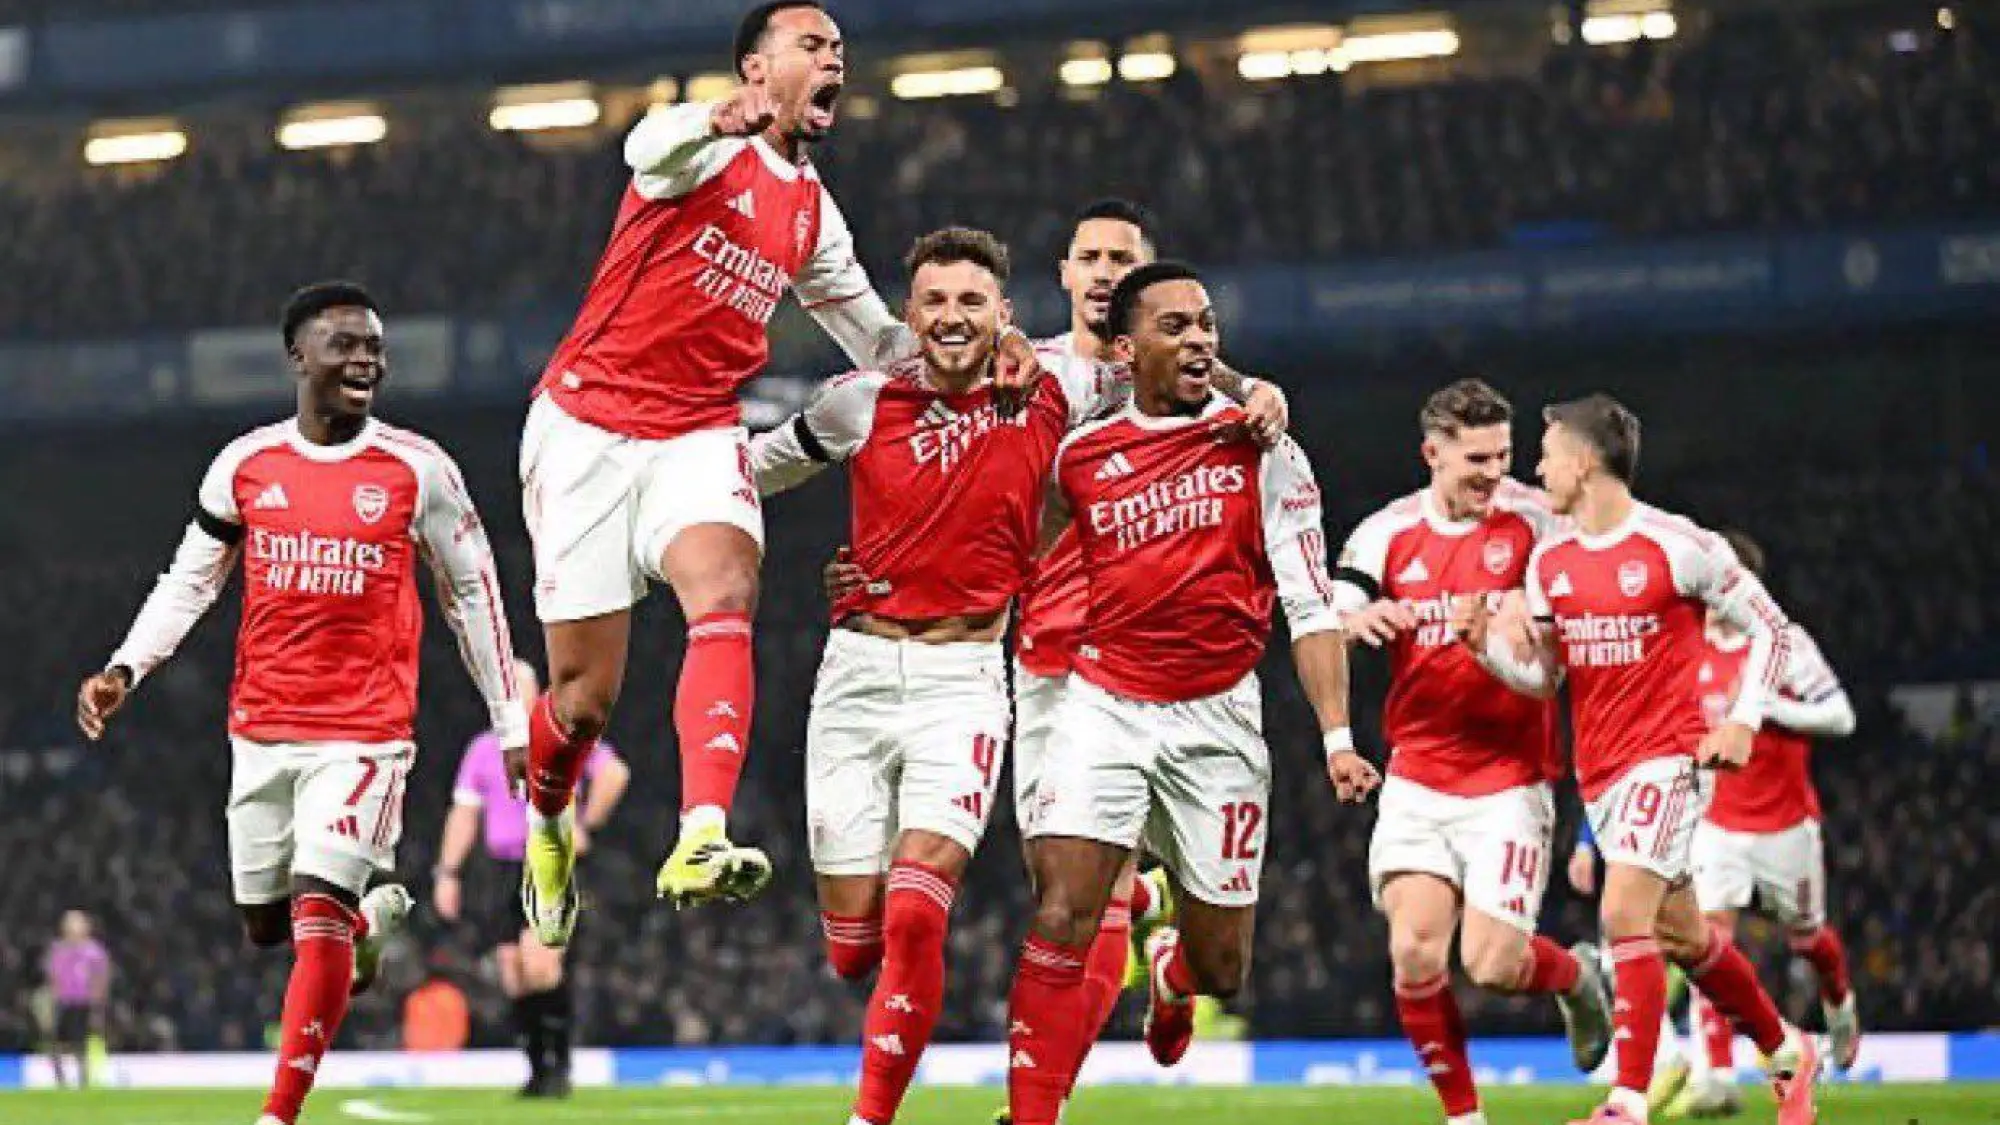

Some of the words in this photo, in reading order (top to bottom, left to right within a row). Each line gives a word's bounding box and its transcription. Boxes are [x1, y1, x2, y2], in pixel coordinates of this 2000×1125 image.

[693, 268, 733, 302] FLY
[1089, 464, 1245, 536] Emirates
[1117, 516, 1149, 552] FLY
[1154, 498, 1223, 536] BETTER
[253, 527, 383, 569] Emirates
[266, 563, 295, 591] FLY
[298, 566, 364, 596] BETTER
[343, 755, 378, 806] 7
[972, 731, 997, 788] 4
[1219, 801, 1262, 859] 12
[1618, 782, 1662, 827] 19
[1500, 840, 1538, 891] 14
